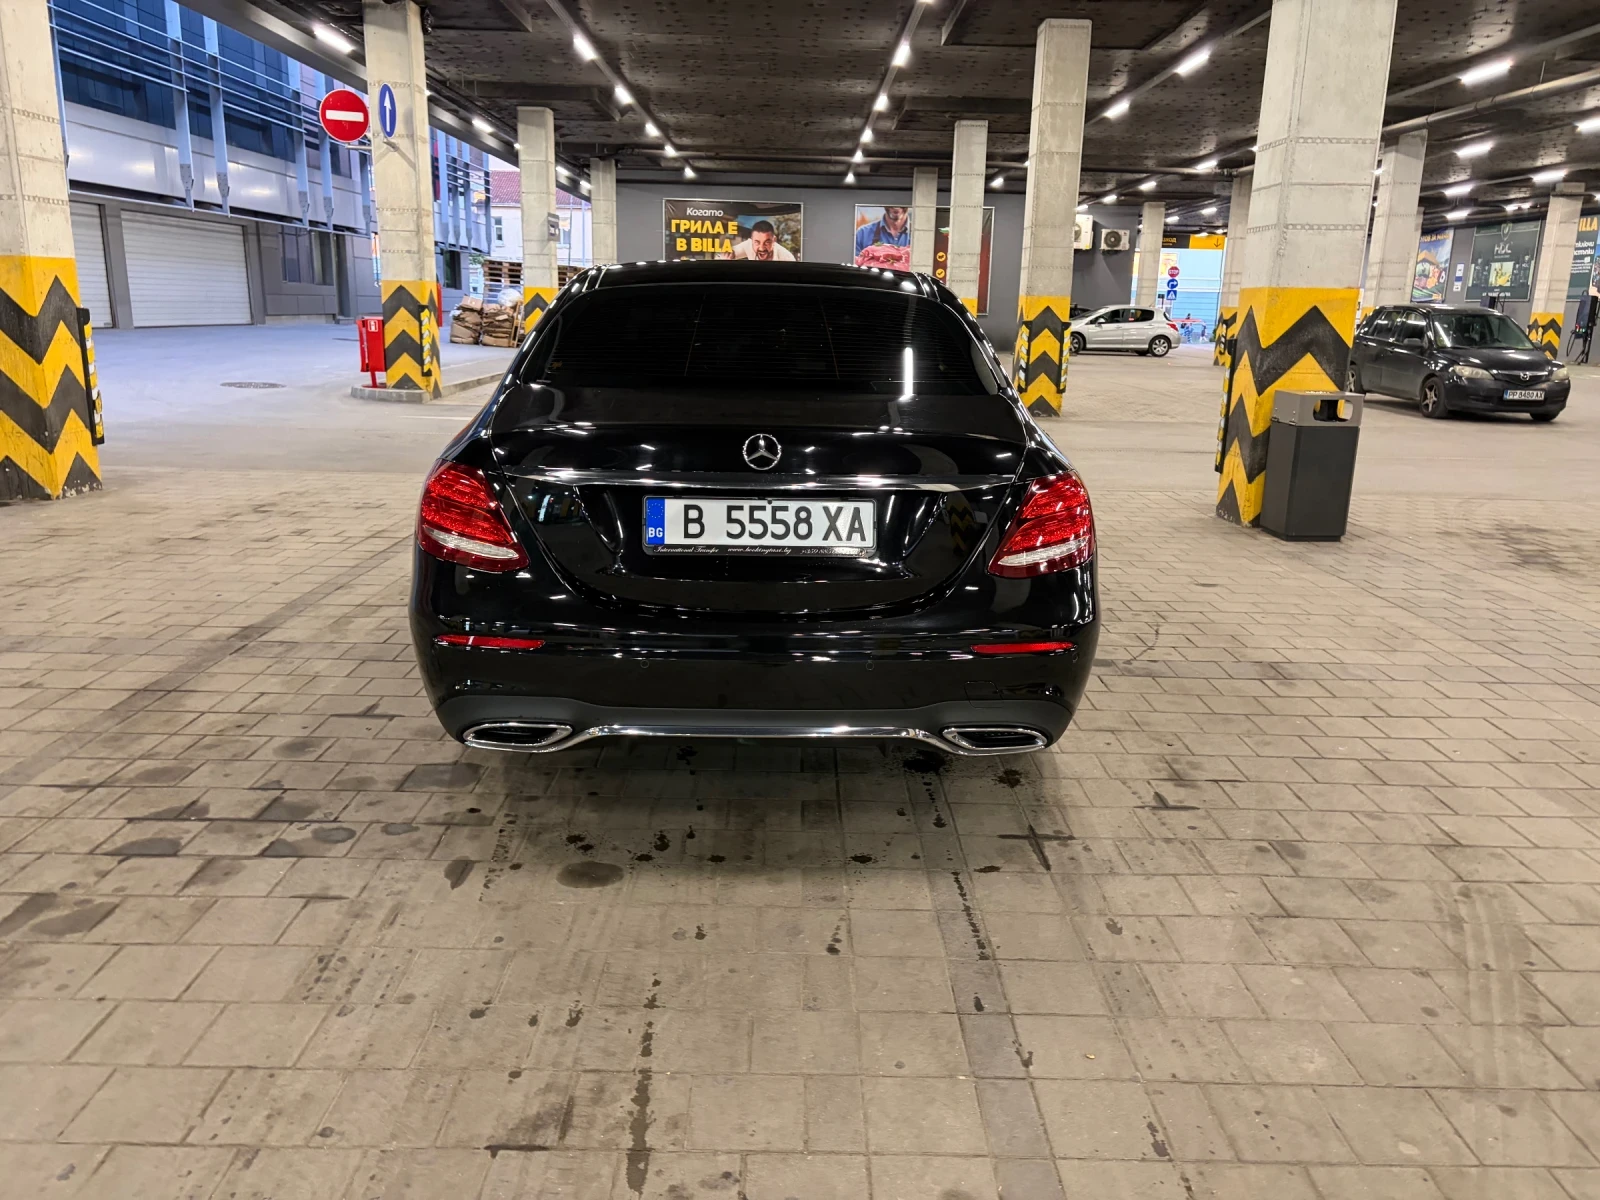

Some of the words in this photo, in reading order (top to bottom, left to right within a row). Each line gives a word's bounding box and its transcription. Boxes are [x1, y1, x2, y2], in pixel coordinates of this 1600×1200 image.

[687, 207, 723, 216] Когато
[671, 219, 725, 235] ГРИЛА
[727, 221, 738, 235] Е
[1579, 217, 1598, 232] ILLA
[676, 237, 687, 251] В
[690, 237, 733, 253] BILLA
[683, 504, 705, 539] B
[726, 505, 813, 541] 5558
[822, 505, 867, 542] XA
[648, 527, 663, 538] BG
[653, 545, 694, 553] International
